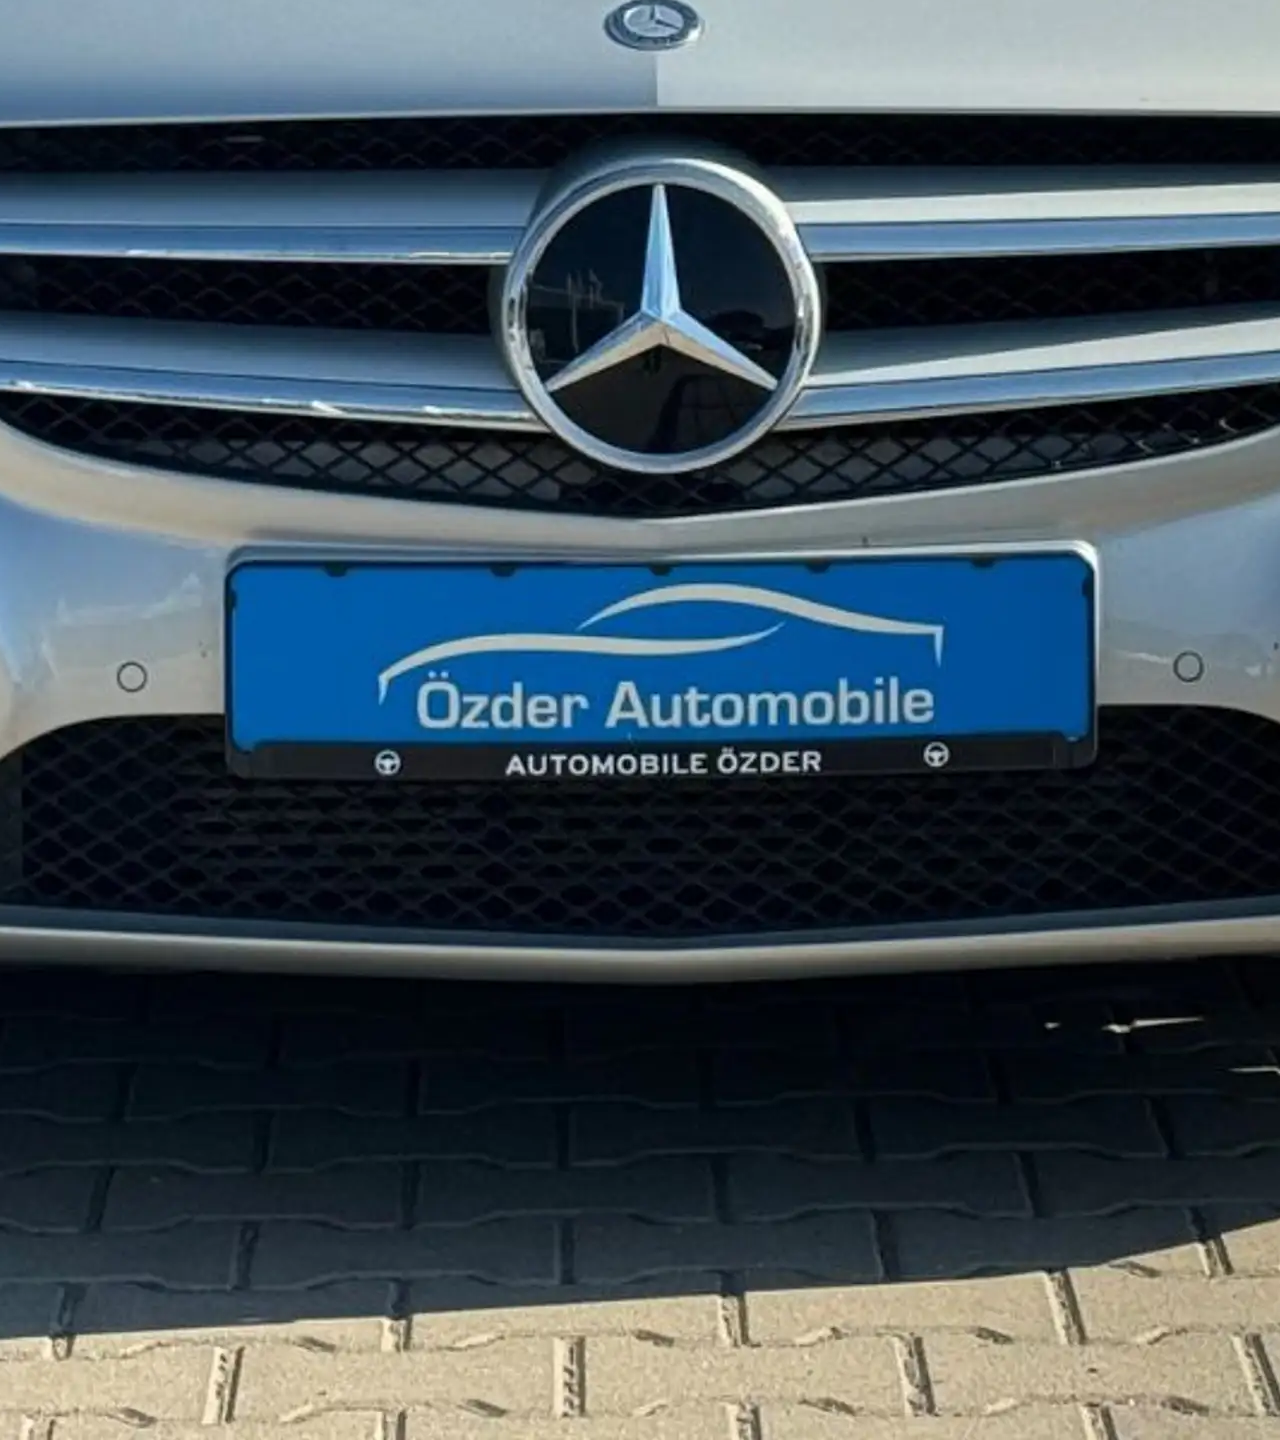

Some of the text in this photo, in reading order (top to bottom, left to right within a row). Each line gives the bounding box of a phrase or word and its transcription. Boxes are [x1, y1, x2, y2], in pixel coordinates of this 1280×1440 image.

[416, 670, 933, 728] Özder Automobile
[505, 747, 821, 776] AUTOMOBILE ÖZDER
